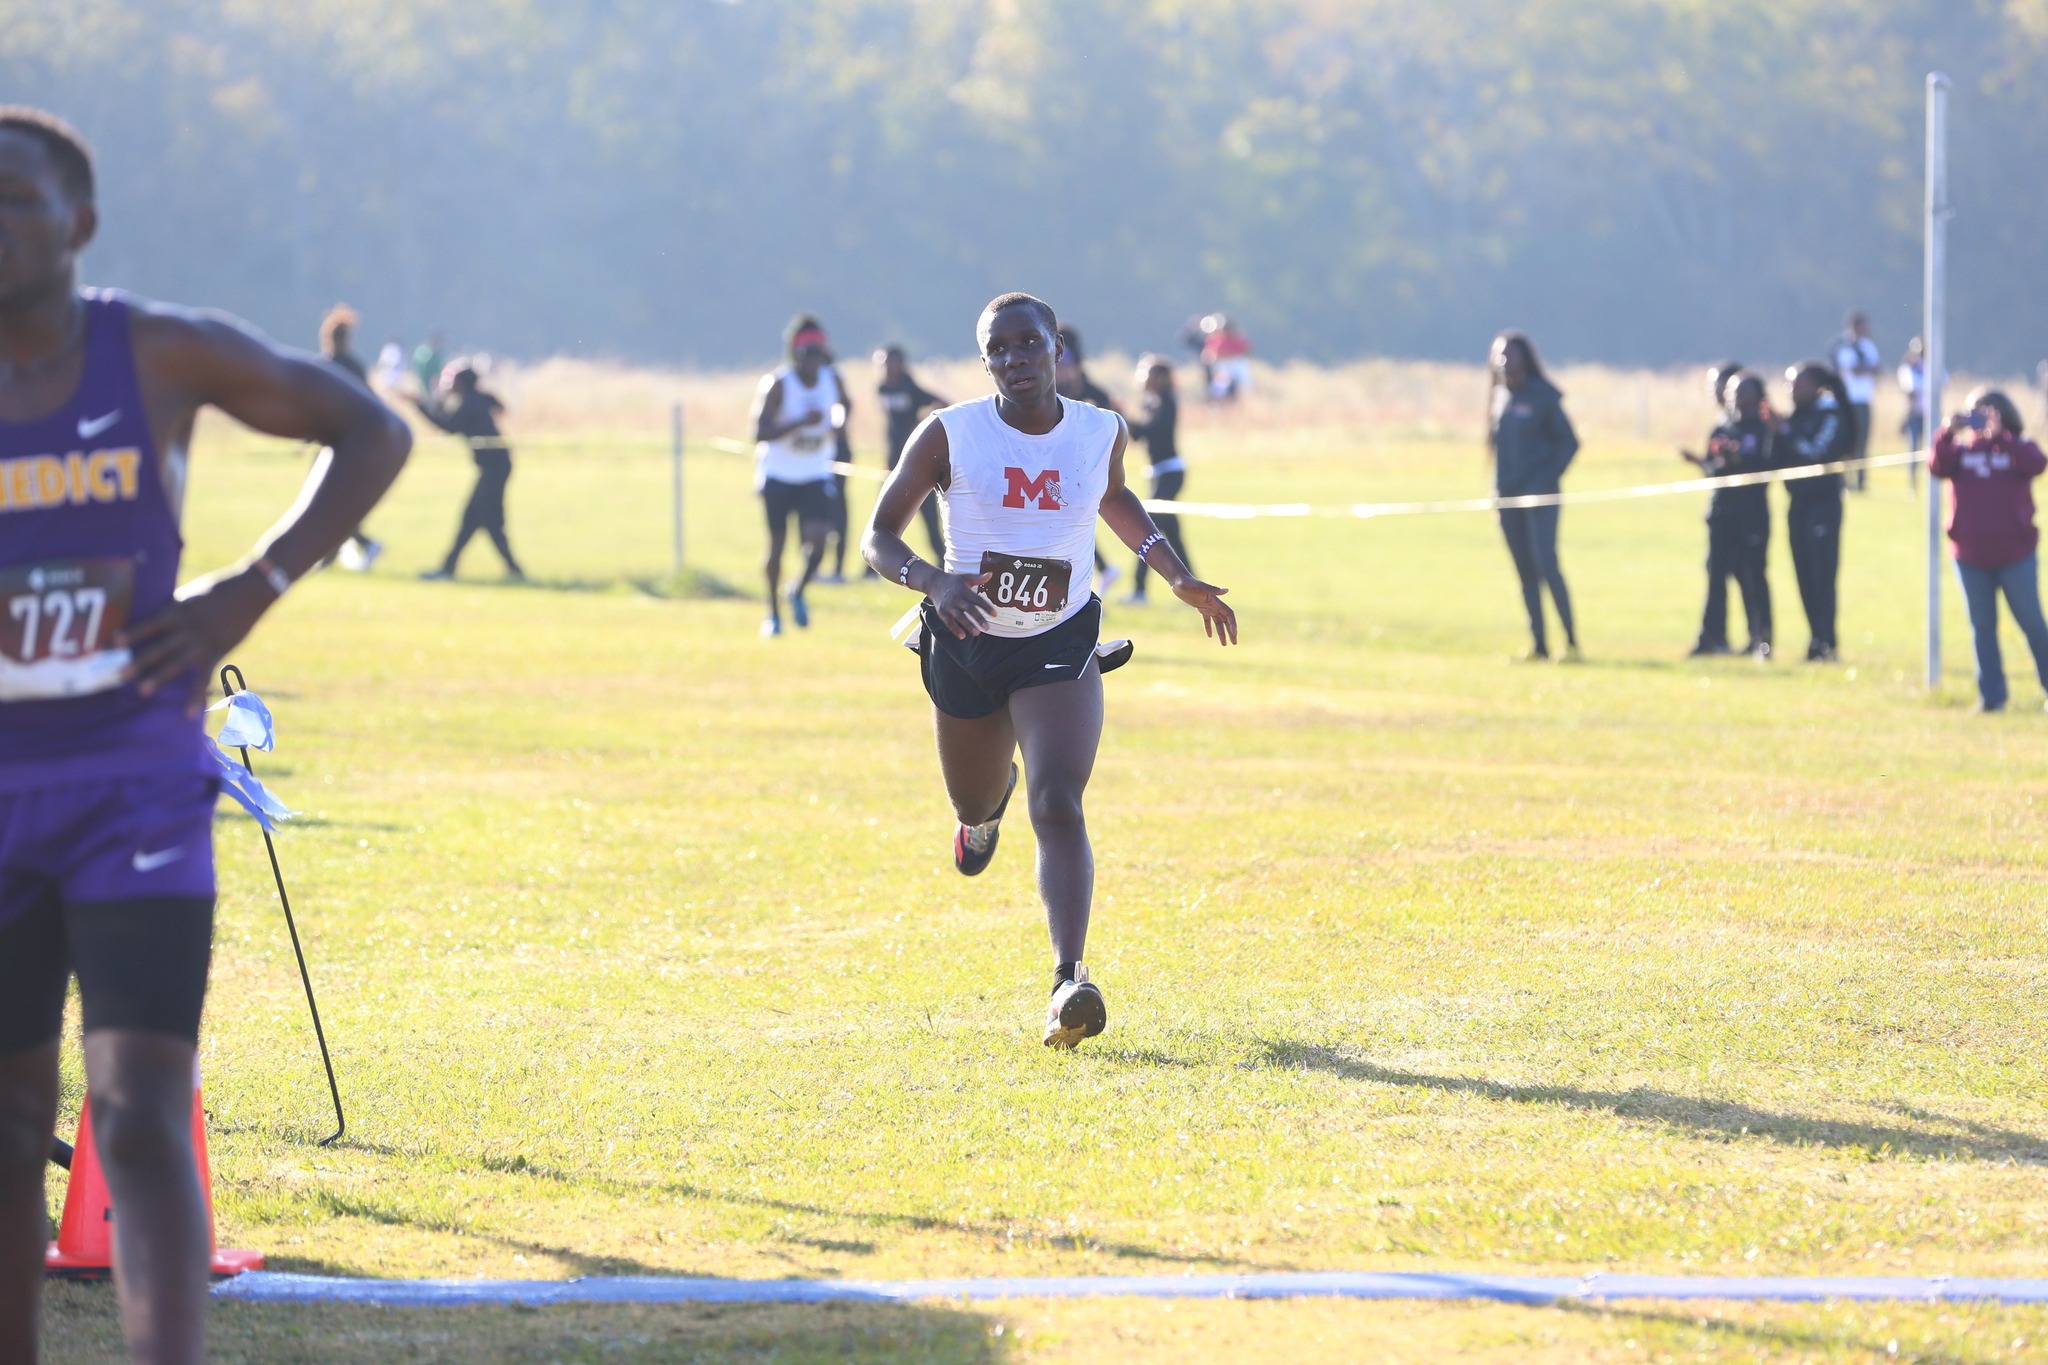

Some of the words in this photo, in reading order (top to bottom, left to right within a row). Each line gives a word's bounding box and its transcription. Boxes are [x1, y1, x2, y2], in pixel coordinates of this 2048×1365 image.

[0, 446, 140, 513] EDICT
[1003, 467, 1060, 510] M
[997, 572, 1048, 608] 846
[10, 587, 106, 660] 727
